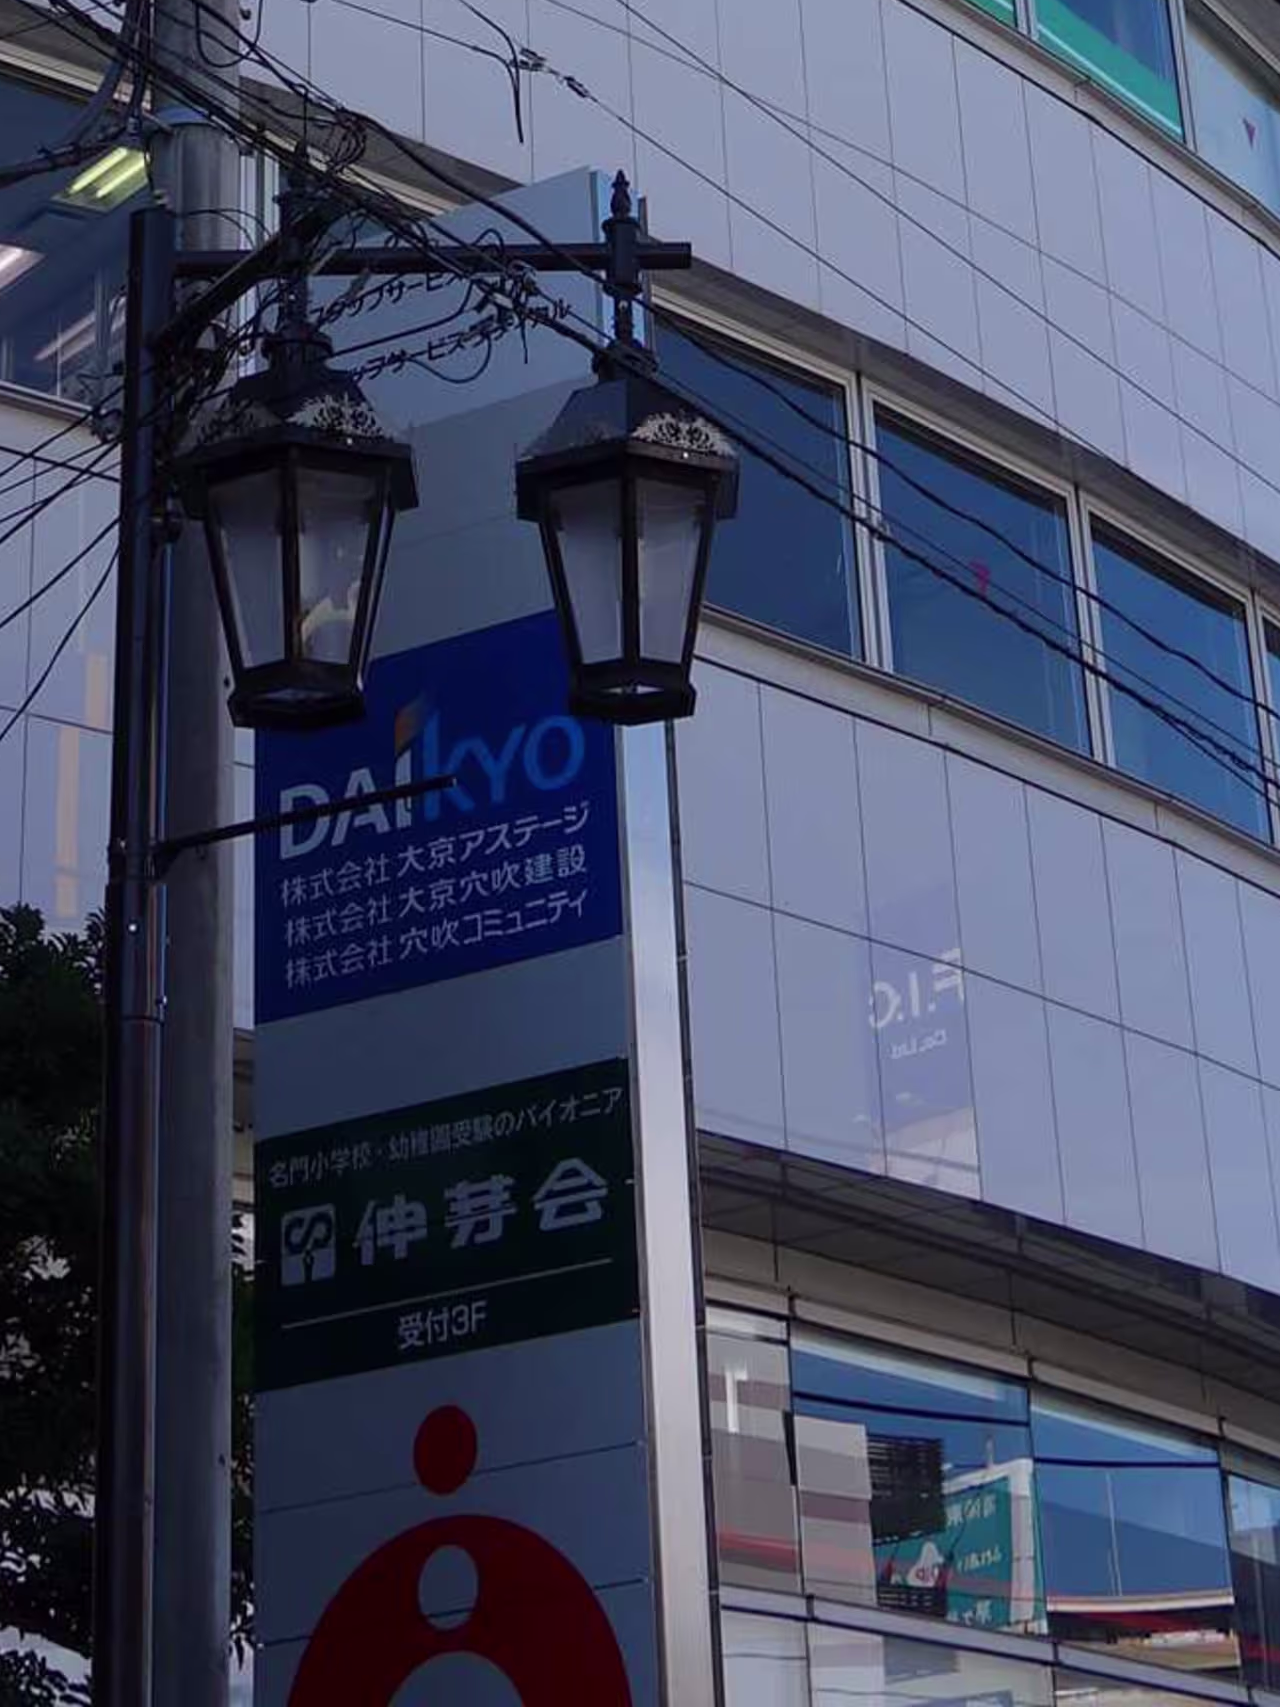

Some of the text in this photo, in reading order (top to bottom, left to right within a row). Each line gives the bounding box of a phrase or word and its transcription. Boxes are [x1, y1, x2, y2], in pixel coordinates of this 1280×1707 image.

[282, 800, 590, 907] 株式会社 大京アステージ
[286, 843, 587, 949] 株式会社 大京穴吹建設
[287, 888, 590, 990] 株式会社 穴吹コミュニティ
[353, 1156, 610, 1267] 伸芽会
[397, 1300, 488, 1350] 受付3F
